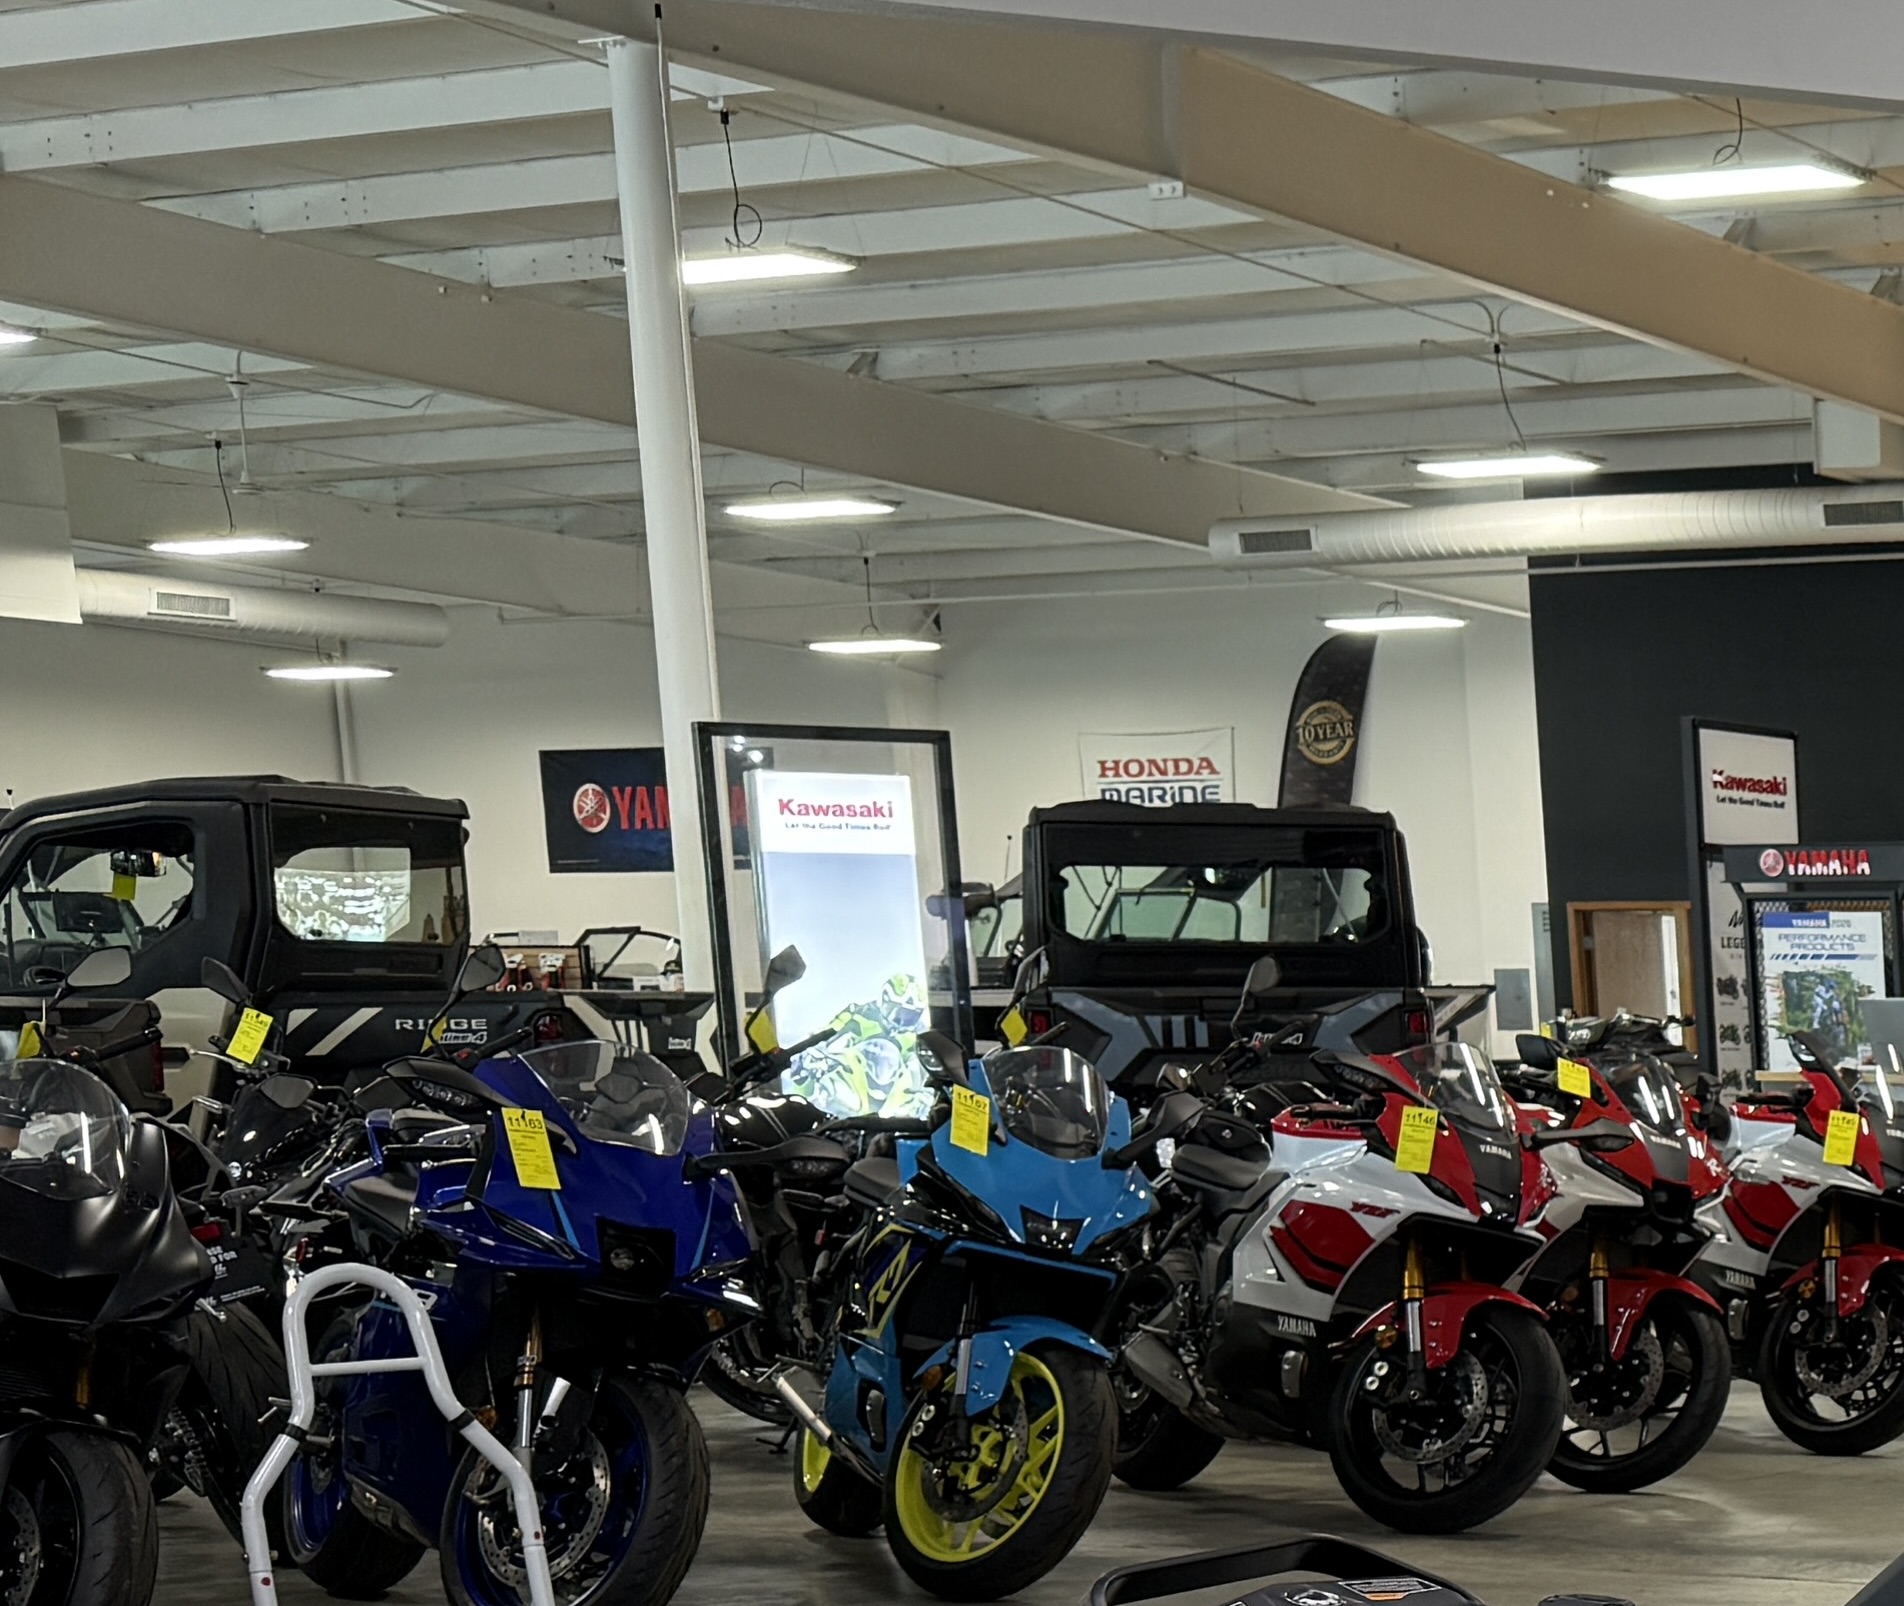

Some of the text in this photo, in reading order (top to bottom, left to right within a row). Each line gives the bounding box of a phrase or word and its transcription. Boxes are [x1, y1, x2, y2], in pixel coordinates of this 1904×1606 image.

[1297, 720, 1355, 743] 10 YEAR
[1096, 757, 1221, 778] HONDA
[1712, 768, 1788, 796] Kawasaki
[1100, 785, 1221, 804] MARINE
[777, 798, 895, 819] Kawasaki
[1785, 849, 1871, 876] YAMAHA
[1777, 933, 1867, 943] PERFORMANCE
[1789, 942, 1856, 951] PRODUCTS
[1479, 1143, 1512, 1160] YAMAHA
[1725, 1269, 1756, 1290] YAMAHA
[1277, 1314, 1317, 1338] YAMAHA
